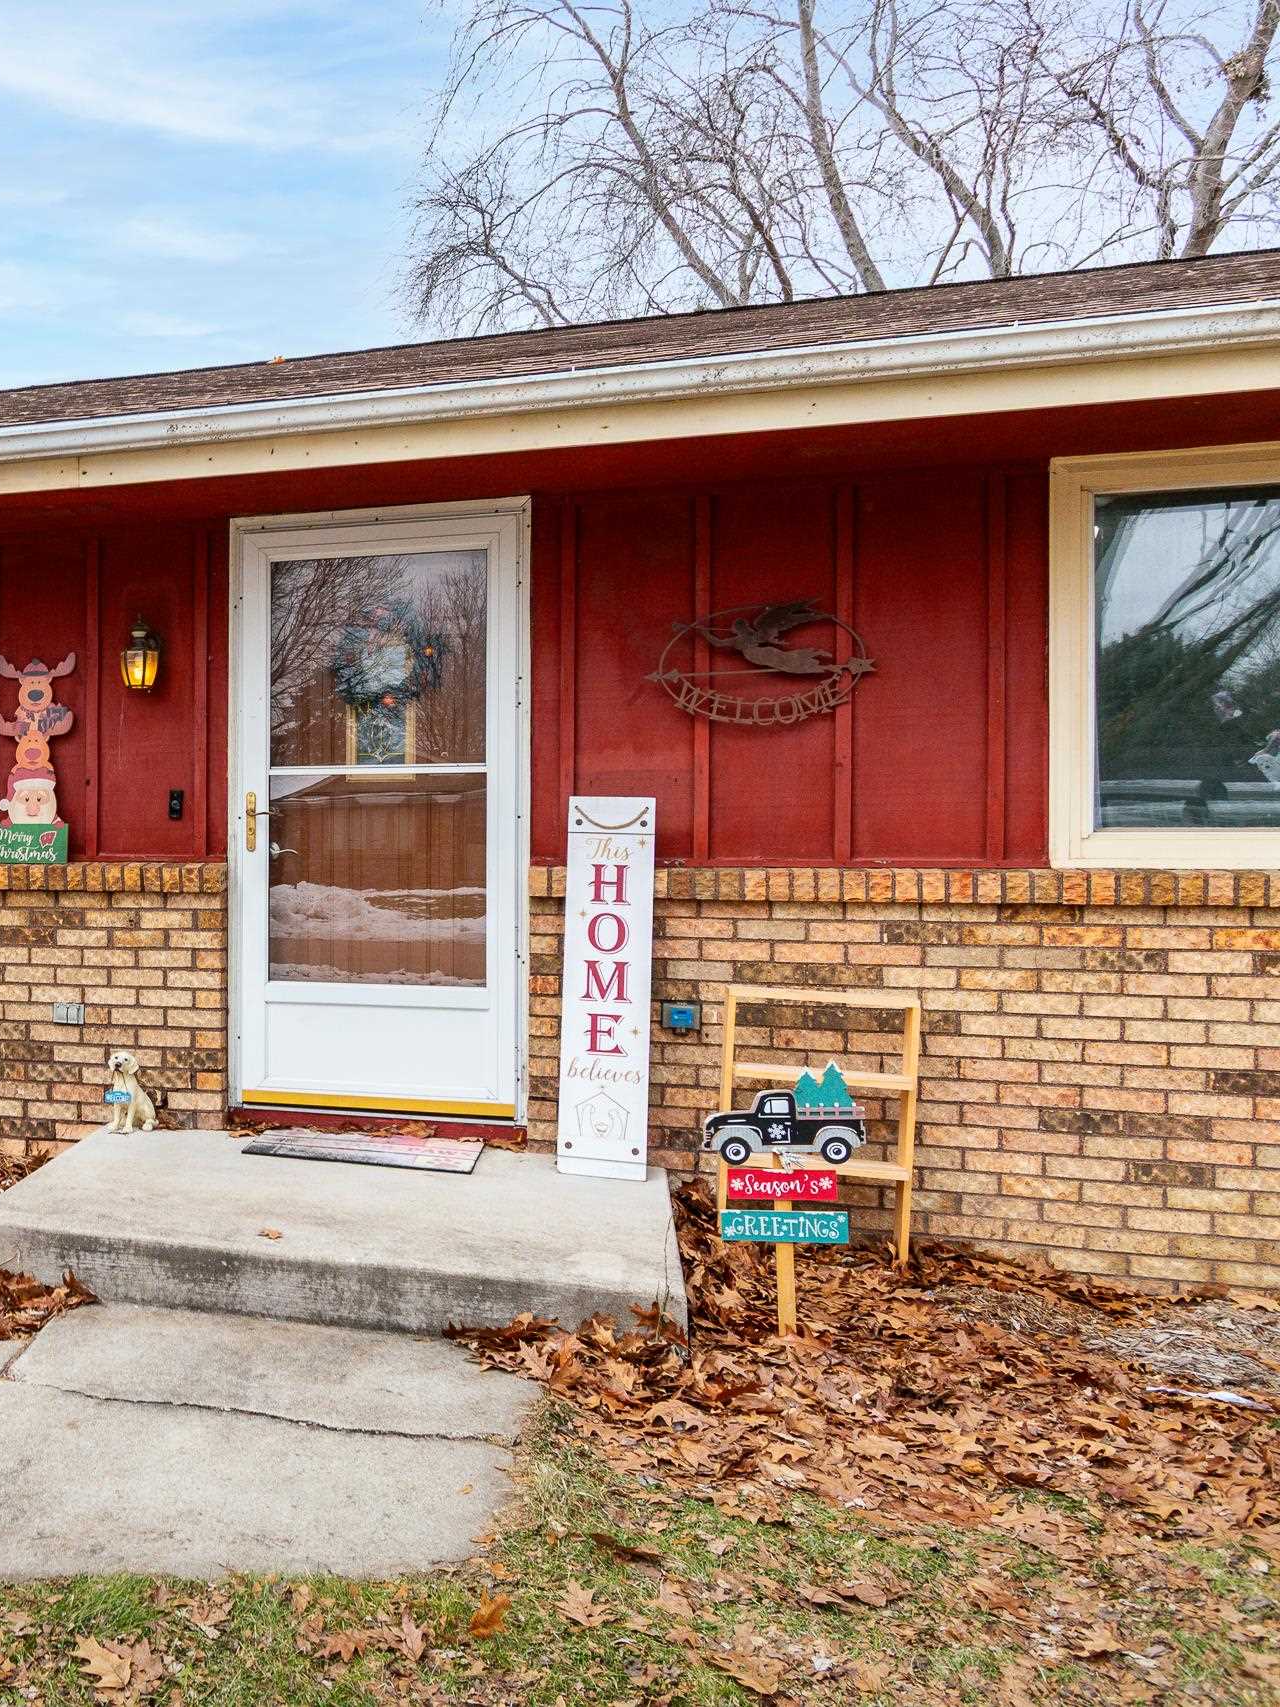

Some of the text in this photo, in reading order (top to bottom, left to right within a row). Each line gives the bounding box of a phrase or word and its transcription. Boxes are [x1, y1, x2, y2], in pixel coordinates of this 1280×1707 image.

[673, 670, 848, 725] WELCOME
[585, 837, 634, 860] This
[581, 863, 632, 1057] HOME
[567, 1056, 645, 1085] believes
[744, 1174, 818, 1197] Season's
[731, 1215, 840, 1239] GREETINGS
